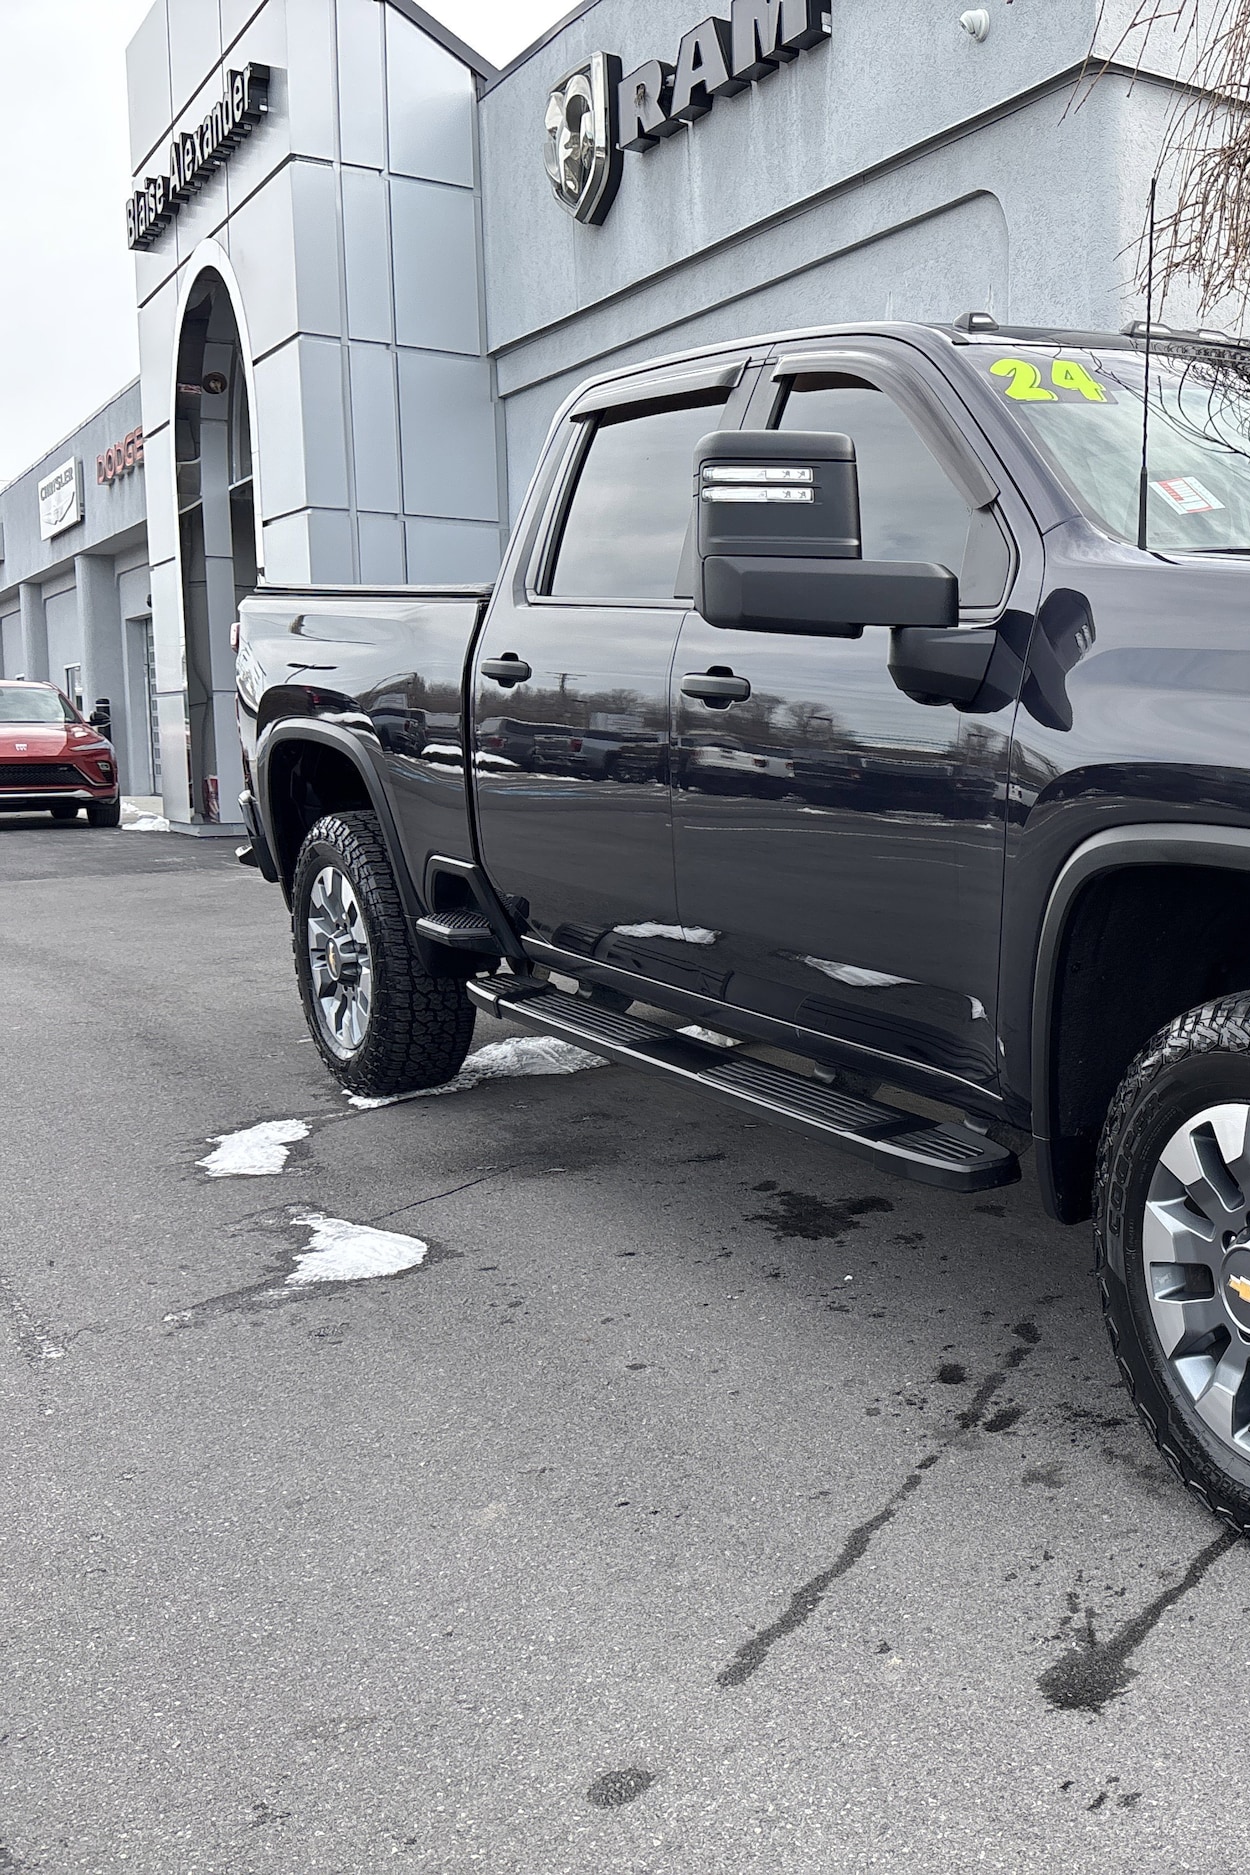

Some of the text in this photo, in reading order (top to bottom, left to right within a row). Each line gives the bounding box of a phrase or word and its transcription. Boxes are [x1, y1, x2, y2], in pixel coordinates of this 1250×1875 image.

[617, 0, 822, 151] RAM
[126, 61, 262, 250] Blaise Alexander
[989, 358, 1107, 402] 24
[40, 467, 74, 501] CHRYSLER
[96, 425, 145, 485] DODGE
